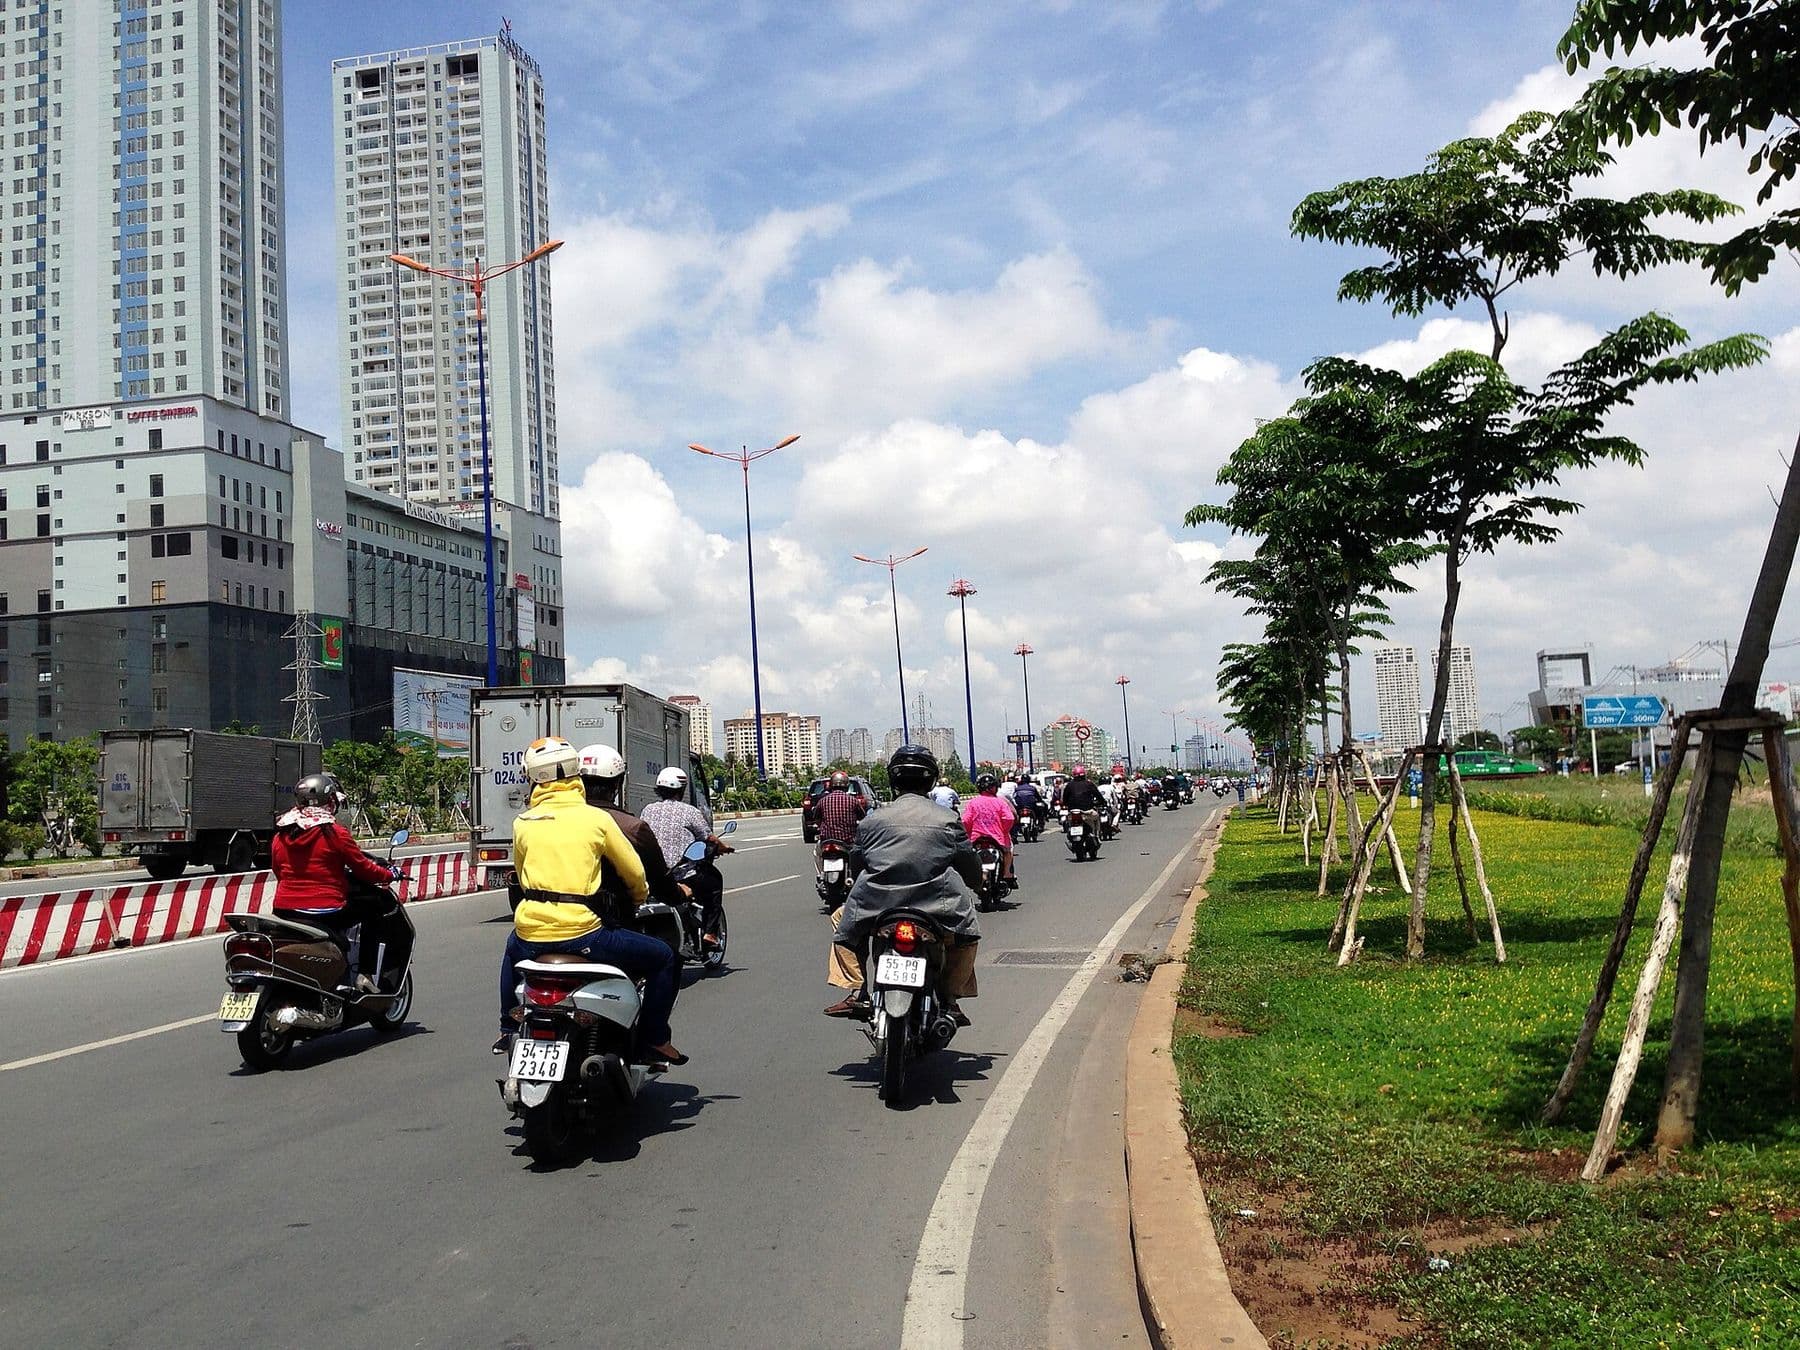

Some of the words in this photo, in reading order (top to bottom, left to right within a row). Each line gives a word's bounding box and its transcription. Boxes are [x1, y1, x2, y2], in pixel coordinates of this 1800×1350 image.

[63, 409, 111, 421] PARKSON
[127, 410, 158, 421] LOTTE
[160, 406, 198, 418] CINEMA
[406, 501, 447, 525] PARKSON
[1593, 716, 1615, 724] 230m
[1633, 715, 1655, 723] 300m
[494, 770, 530, 786] 024.3
[521, 1043, 561, 1060] 54-F5
[518, 1060, 558, 1078] 2348
